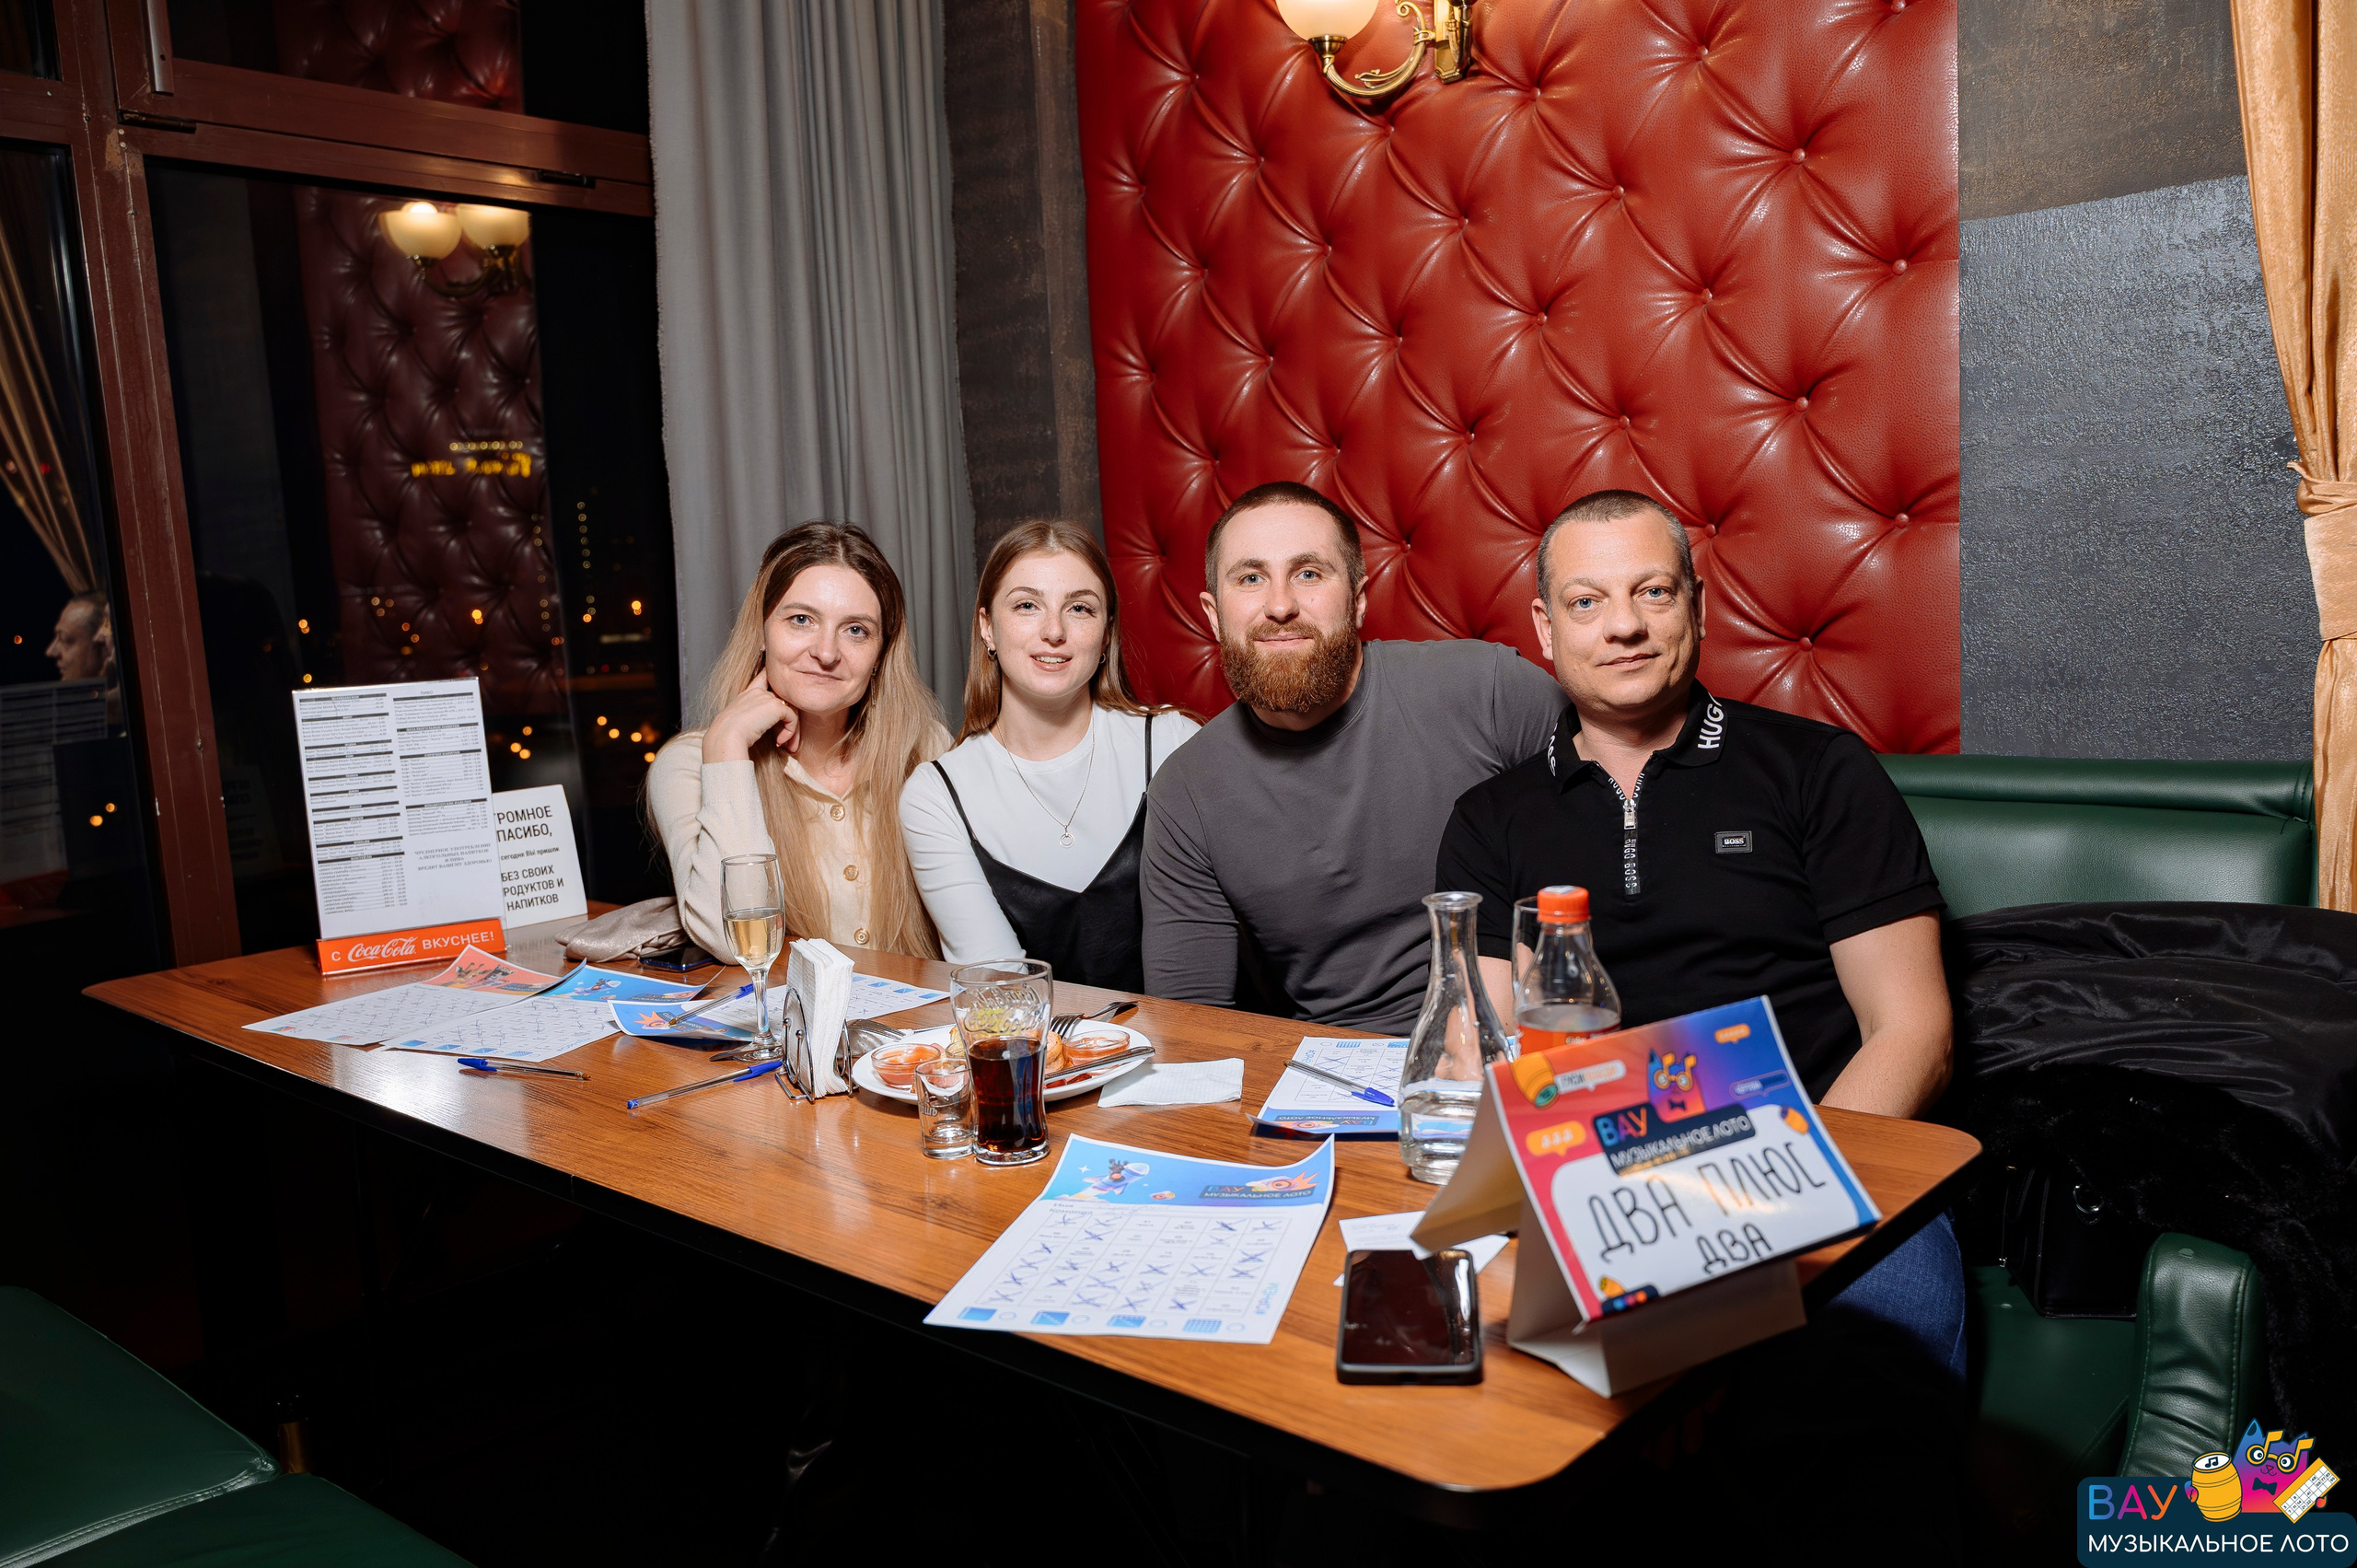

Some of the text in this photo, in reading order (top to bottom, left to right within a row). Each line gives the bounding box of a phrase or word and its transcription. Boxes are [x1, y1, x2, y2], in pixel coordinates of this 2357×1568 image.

[493, 806, 552, 825] РОМНОЕ
[497, 823, 552, 842] ПАСИБО,
[501, 851, 525, 861] сегодня
[537, 847, 560, 855] пришли
[501, 865, 555, 882] БЕЗ СВОИХ
[503, 877, 564, 897] РОДУКТОВ И
[506, 893, 560, 912] НАПИТКОВ
[331, 931, 494, 962] С Coca-Cola ВКУСНЕЕ!
[1595, 1107, 1648, 1147] ВАУ
[1611, 1115, 1753, 1168] МУЗЫКАЛЬНОЕ ЛОТО
[1283, 1190, 1312, 1198] ЛОТО
[1588, 1142, 1827, 1264] ДВА ПЛЮС
[1696, 1223, 1773, 1274] ДВА
